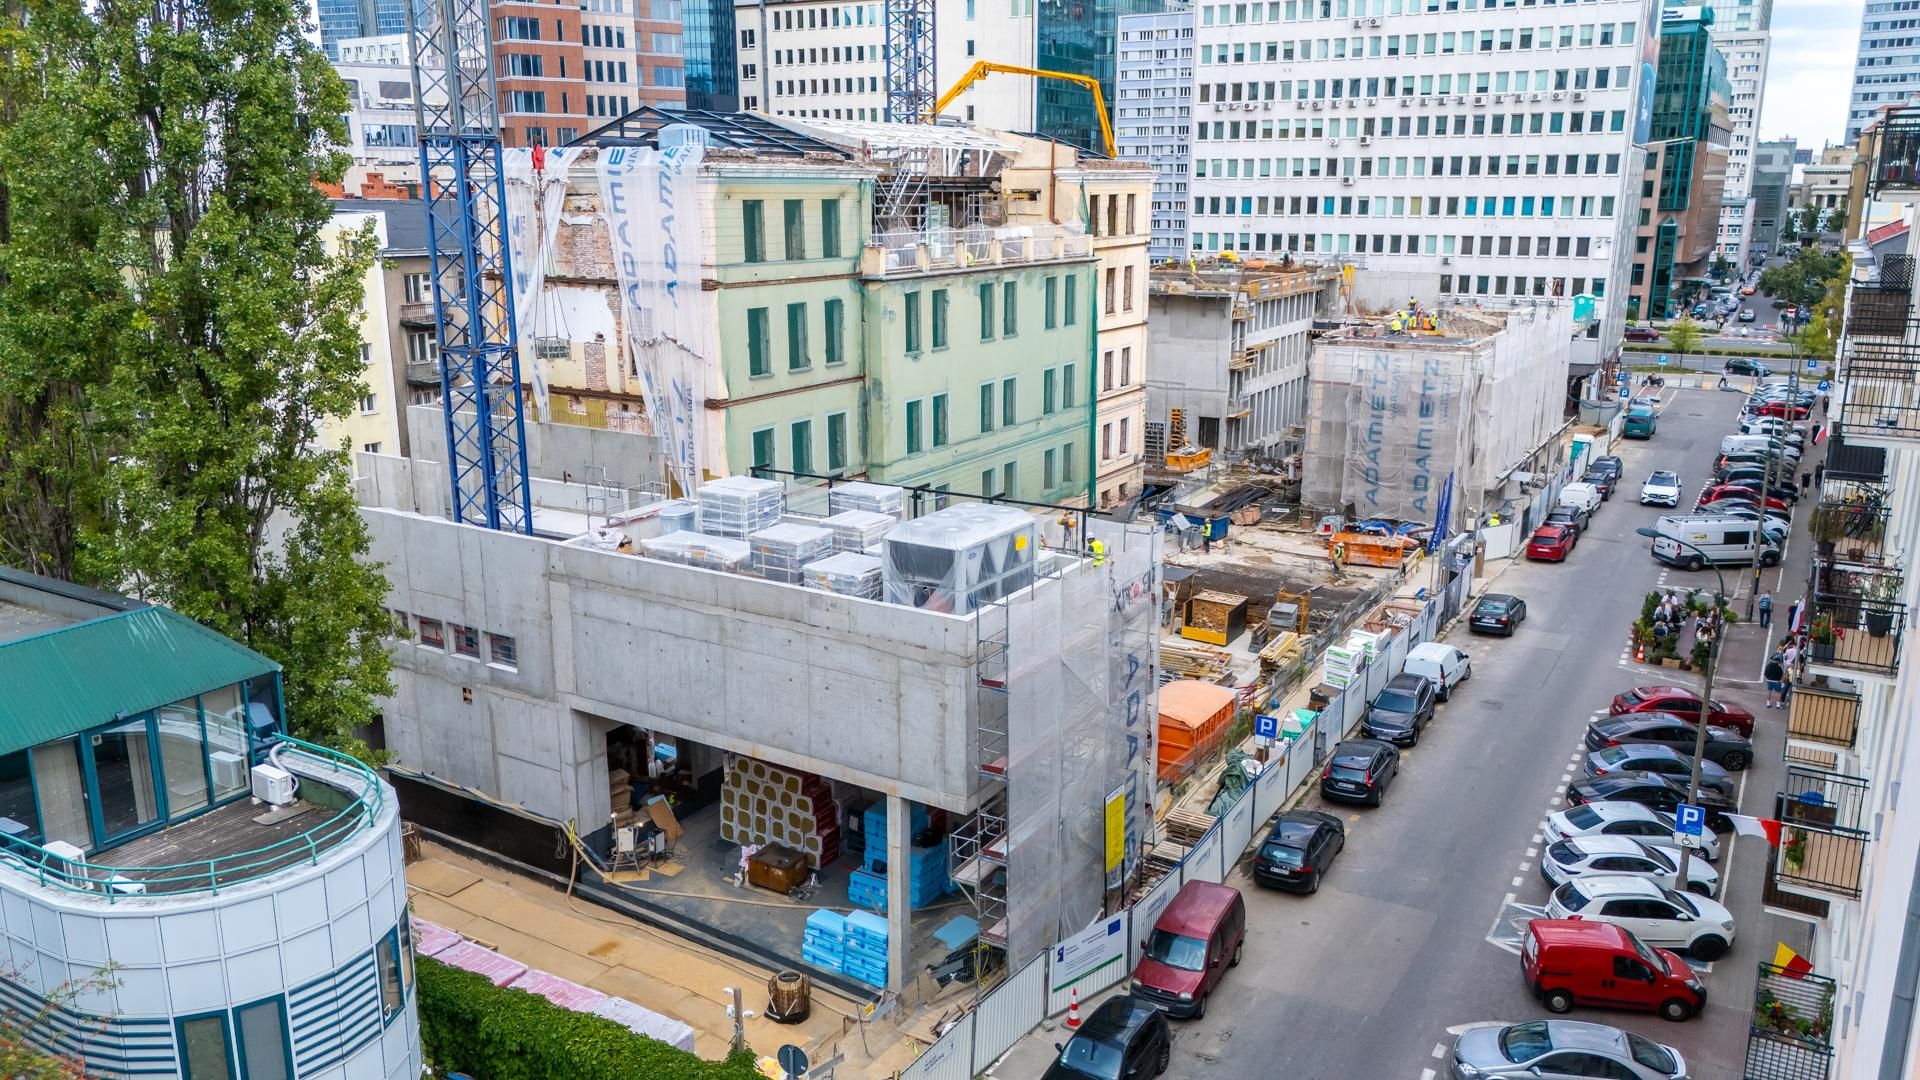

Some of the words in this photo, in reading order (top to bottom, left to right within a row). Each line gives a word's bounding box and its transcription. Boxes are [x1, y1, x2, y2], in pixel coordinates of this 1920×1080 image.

[1390, 357, 1401, 420] WARSZAWA
[1365, 352, 1389, 506] ADAMIETZ
[1412, 359, 1440, 514] ADAMIETZ
[1260, 718, 1273, 734] P
[1682, 807, 1699, 825] P
